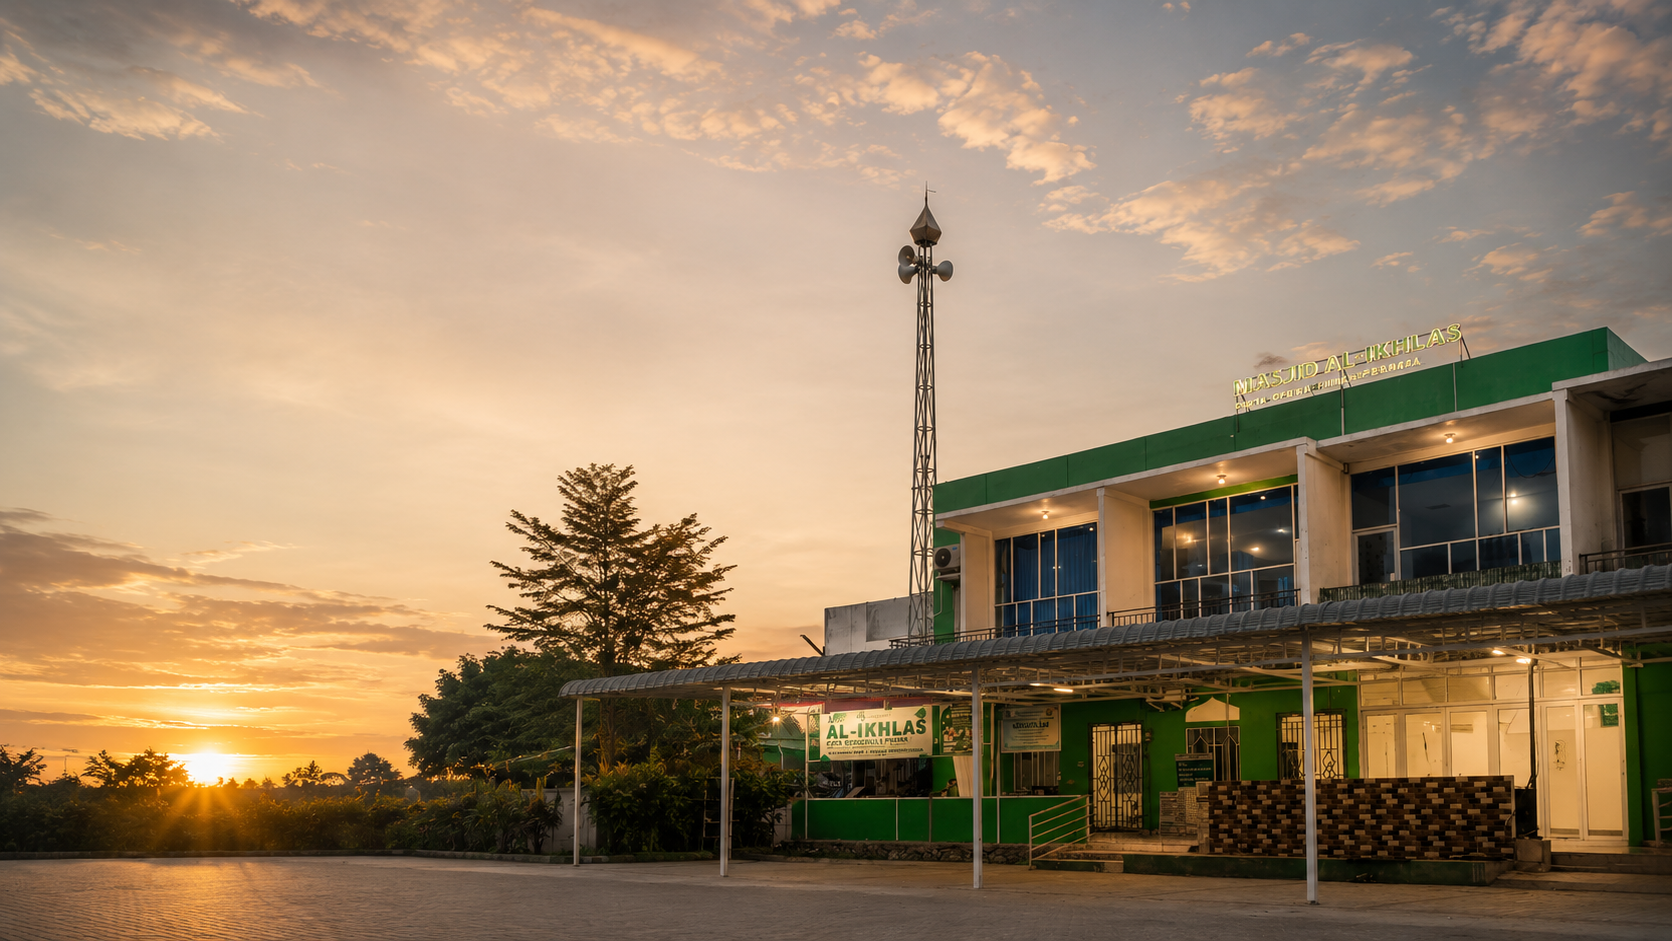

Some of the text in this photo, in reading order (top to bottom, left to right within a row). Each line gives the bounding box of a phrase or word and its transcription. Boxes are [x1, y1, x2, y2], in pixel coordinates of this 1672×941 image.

[1233, 361, 1318, 396] MASJID
[1324, 323, 1462, 374] AL-IKHLAS
[826, 718, 927, 740] AL-IKHLAS
